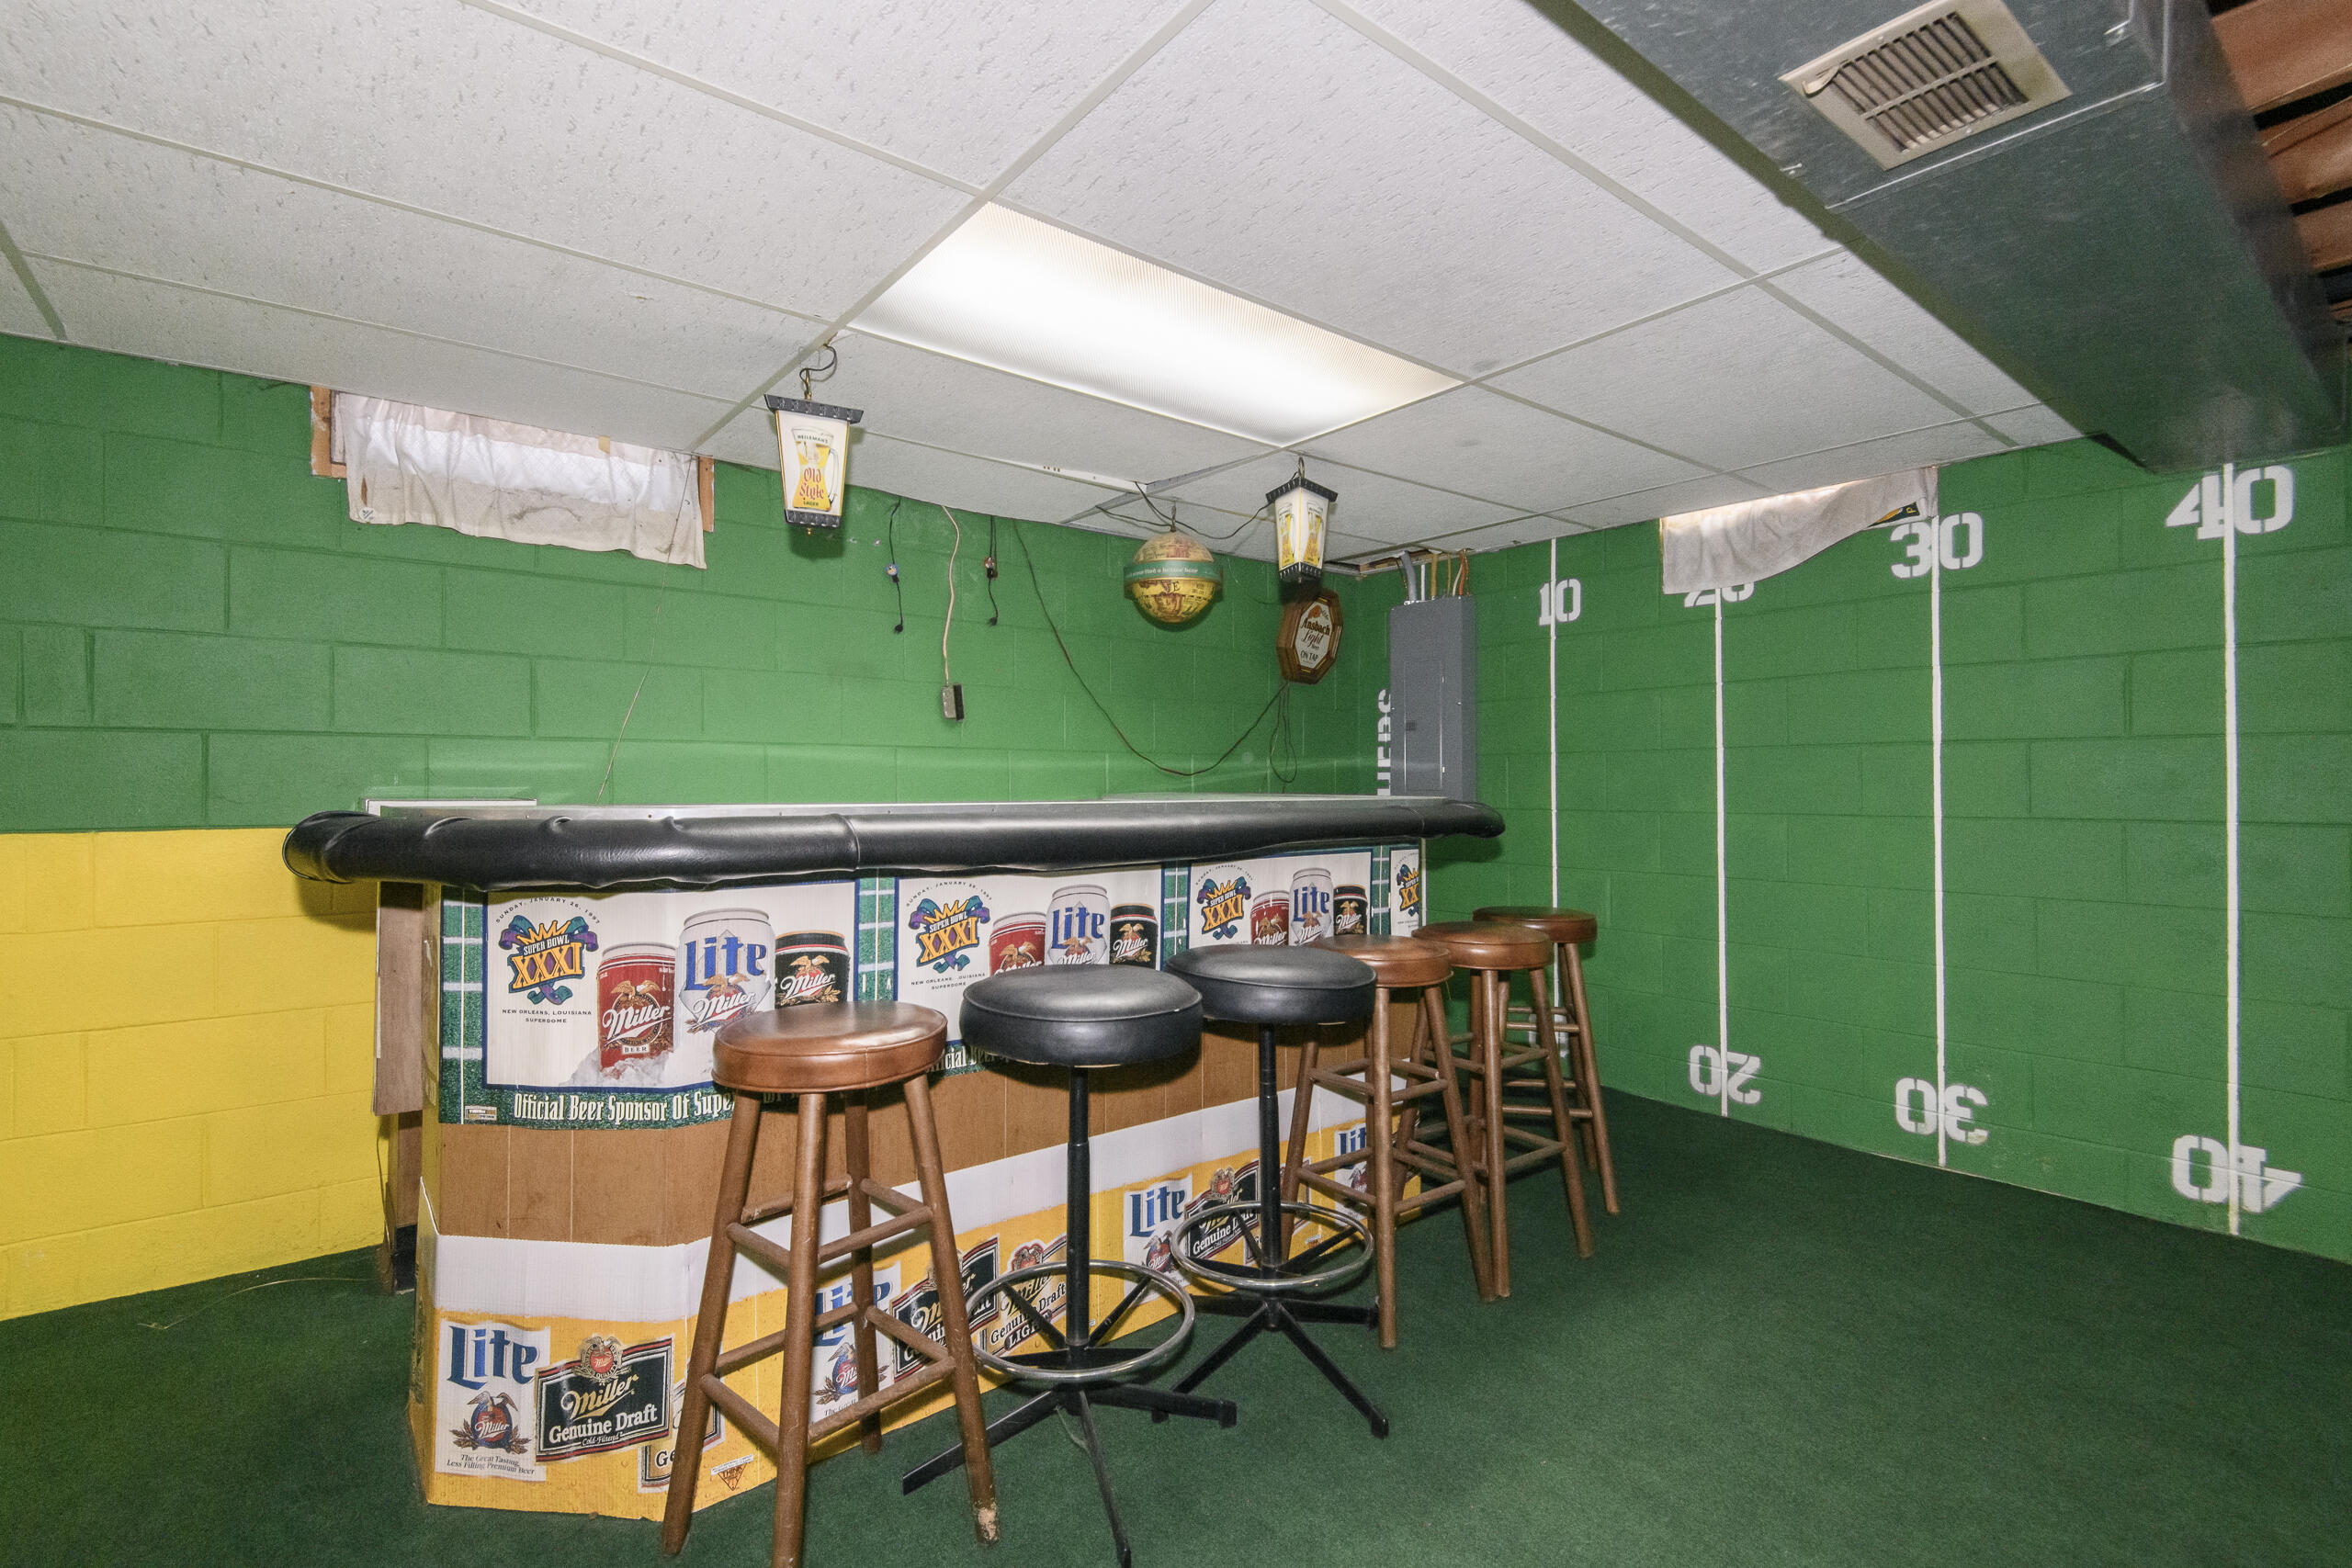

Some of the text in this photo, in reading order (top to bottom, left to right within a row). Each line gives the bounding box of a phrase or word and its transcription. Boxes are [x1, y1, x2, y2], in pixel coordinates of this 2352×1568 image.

[803, 468, 822, 483] Old
[2165, 465, 2294, 539] 40
[1889, 511, 1984, 579] 30
[1538, 579, 1581, 626] 10
[1300, 618, 1331, 637] Ansbach
[1300, 649, 1309, 660] ON
[929, 910, 969, 933] SUPER BOWL
[1203, 894, 1243, 931] XXXI
[1293, 886, 1330, 922] Lite
[919, 917, 978, 964] XXXI
[1051, 907, 1105, 950] Lite
[1335, 914, 1362, 931] Miller
[523, 933, 571, 956] SUPER BOWL
[1113, 938, 1148, 959] Miller
[511, 942, 583, 989] XXXI
[684, 935, 768, 991] Lite
[780, 973, 837, 999] Miller
[602, 1004, 672, 1043] Miller
[693, 992, 757, 1023] Miller
[1689, 1043, 1763, 1105] 20
[514, 1093, 565, 1121] Official
[569, 1095, 605, 1122] Beer
[607, 1095, 669, 1126] Sponsor
[672, 1094, 692, 1121] Of
[1894, 1077, 1989, 1146] 30
[2172, 1134, 2303, 1214] 40
[1128, 1185, 1187, 1237] Lite
[1193, 1224, 1232, 1255] Genuine
[1038, 1281, 1067, 1313] Draft
[447, 1325, 539, 1391] Lite
[560, 1373, 639, 1422] Miller
[474, 1421, 511, 1439] Miller
[548, 1403, 659, 1444] Genuine Draft
[447, 1458, 536, 1475] Less Filling Premium Beer
[460, 1453, 475, 1462] The
